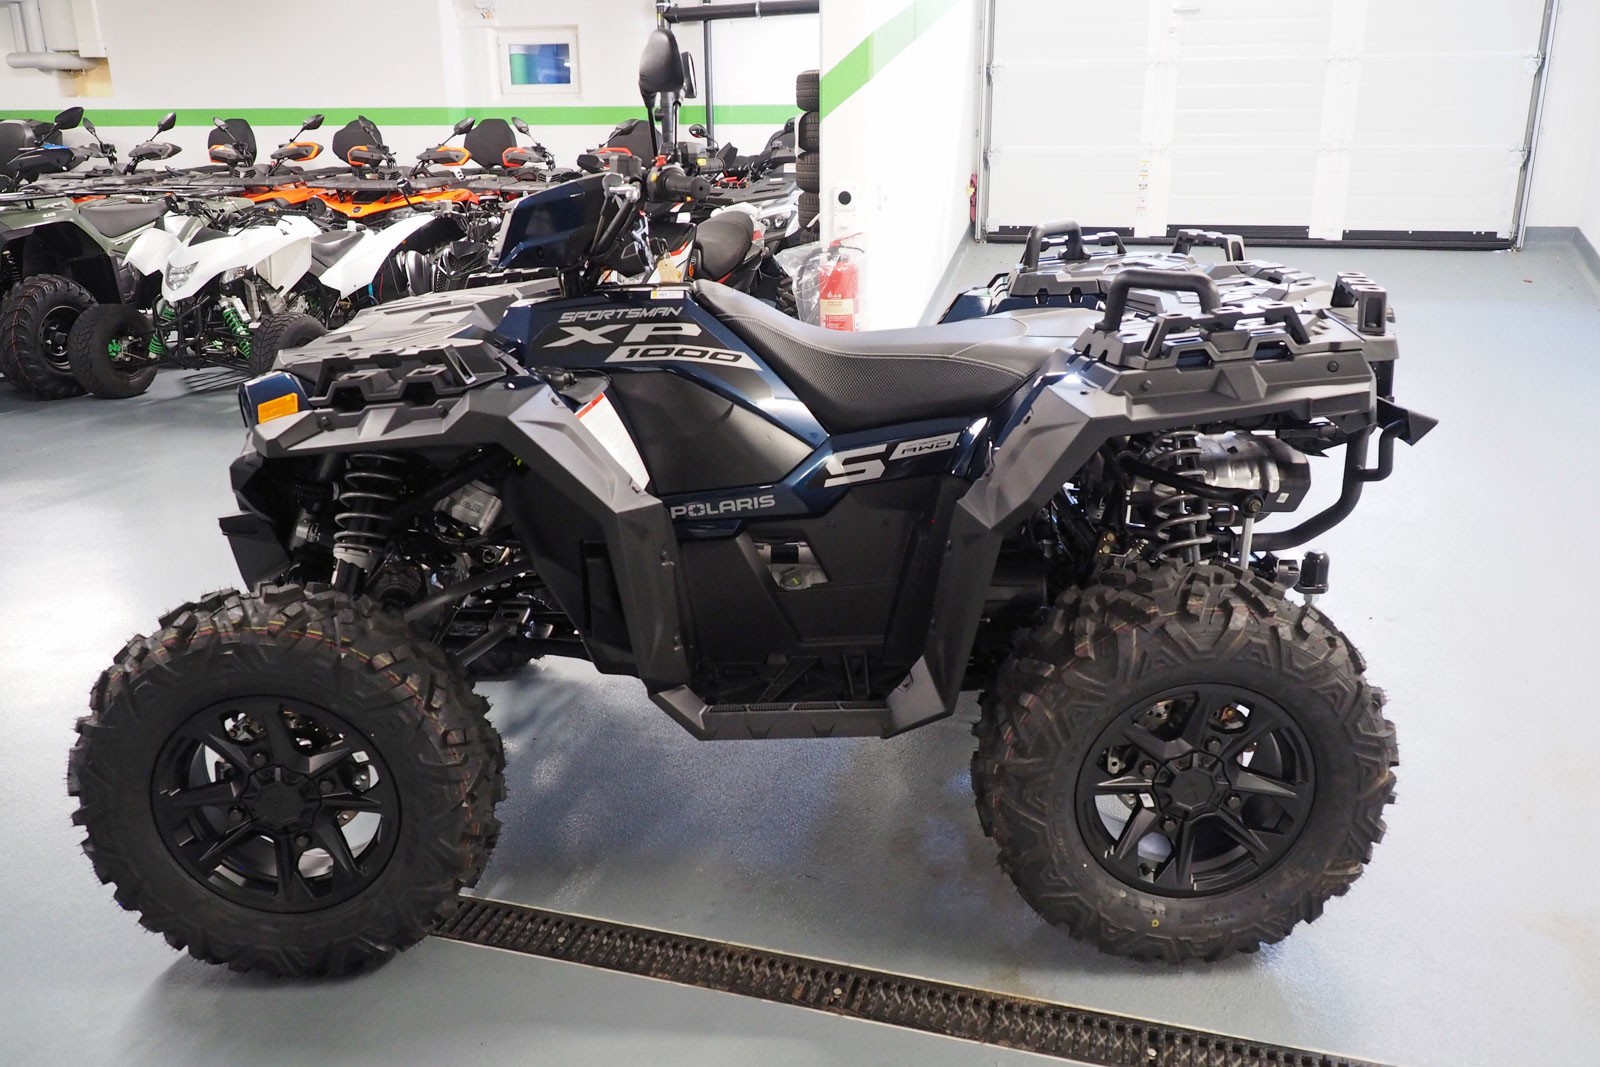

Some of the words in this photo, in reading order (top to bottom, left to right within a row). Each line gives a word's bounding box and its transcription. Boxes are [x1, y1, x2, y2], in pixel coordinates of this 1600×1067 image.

[558, 306, 683, 324] SPORTSMAN
[543, 323, 702, 348] XP
[625, 347, 743, 363] 1000
[901, 440, 952, 455] AWD
[823, 444, 886, 488] S
[670, 494, 776, 519] POLARIS
